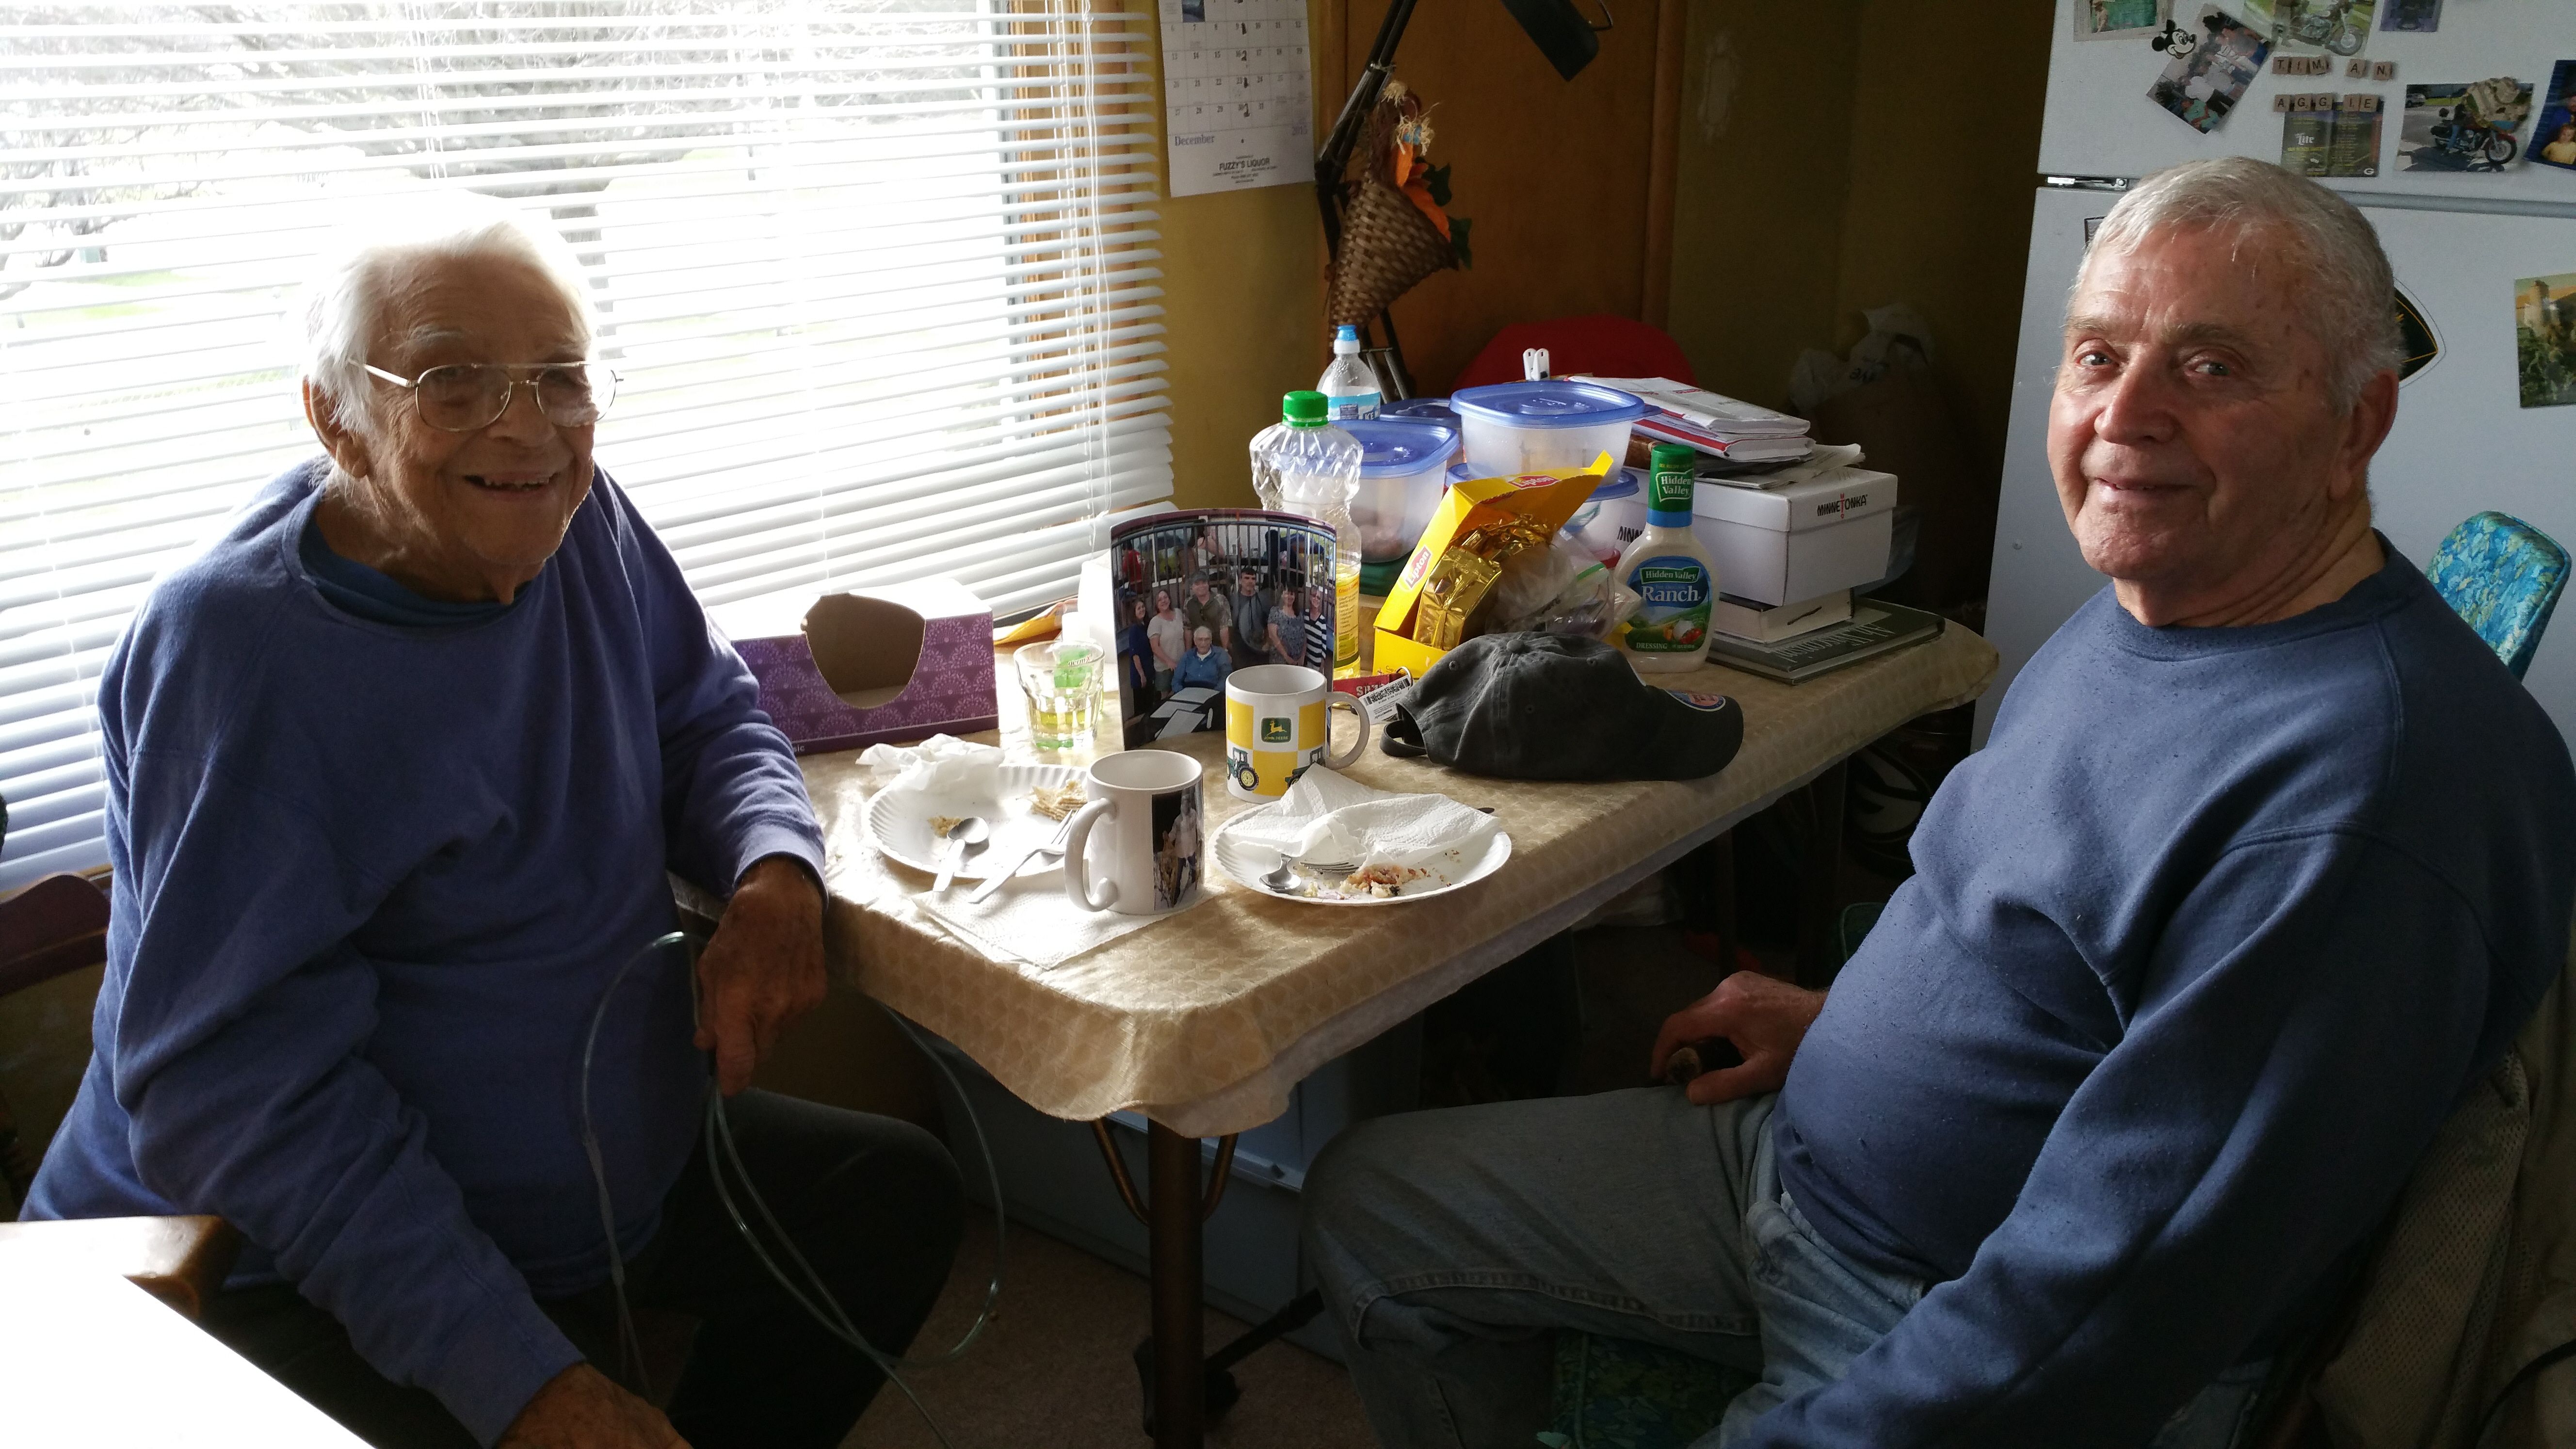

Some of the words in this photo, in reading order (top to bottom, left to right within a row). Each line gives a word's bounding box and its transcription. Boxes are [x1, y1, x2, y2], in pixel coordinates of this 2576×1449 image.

[2277, 59, 2323, 71] TIM
[2350, 63, 2387, 76] AN
[2277, 97, 2373, 109] AGGIE
[1174, 134, 1215, 146] December
[2295, 132, 2315, 145] Lite
[1219, 160, 1245, 171] FUZZY'S
[1246, 157, 1271, 168] LIQUOR
[1513, 475, 1555, 487] Lipton
[1660, 476, 1692, 485] Hidden
[1662, 485, 1690, 497] Valley
[1817, 494, 1868, 517] MINNETONKA
[1405, 550, 1430, 586] Lipton
[1645, 570, 1673, 579] Hidden
[1674, 571, 1697, 580] Valley
[1642, 585, 1699, 602] Ranch
